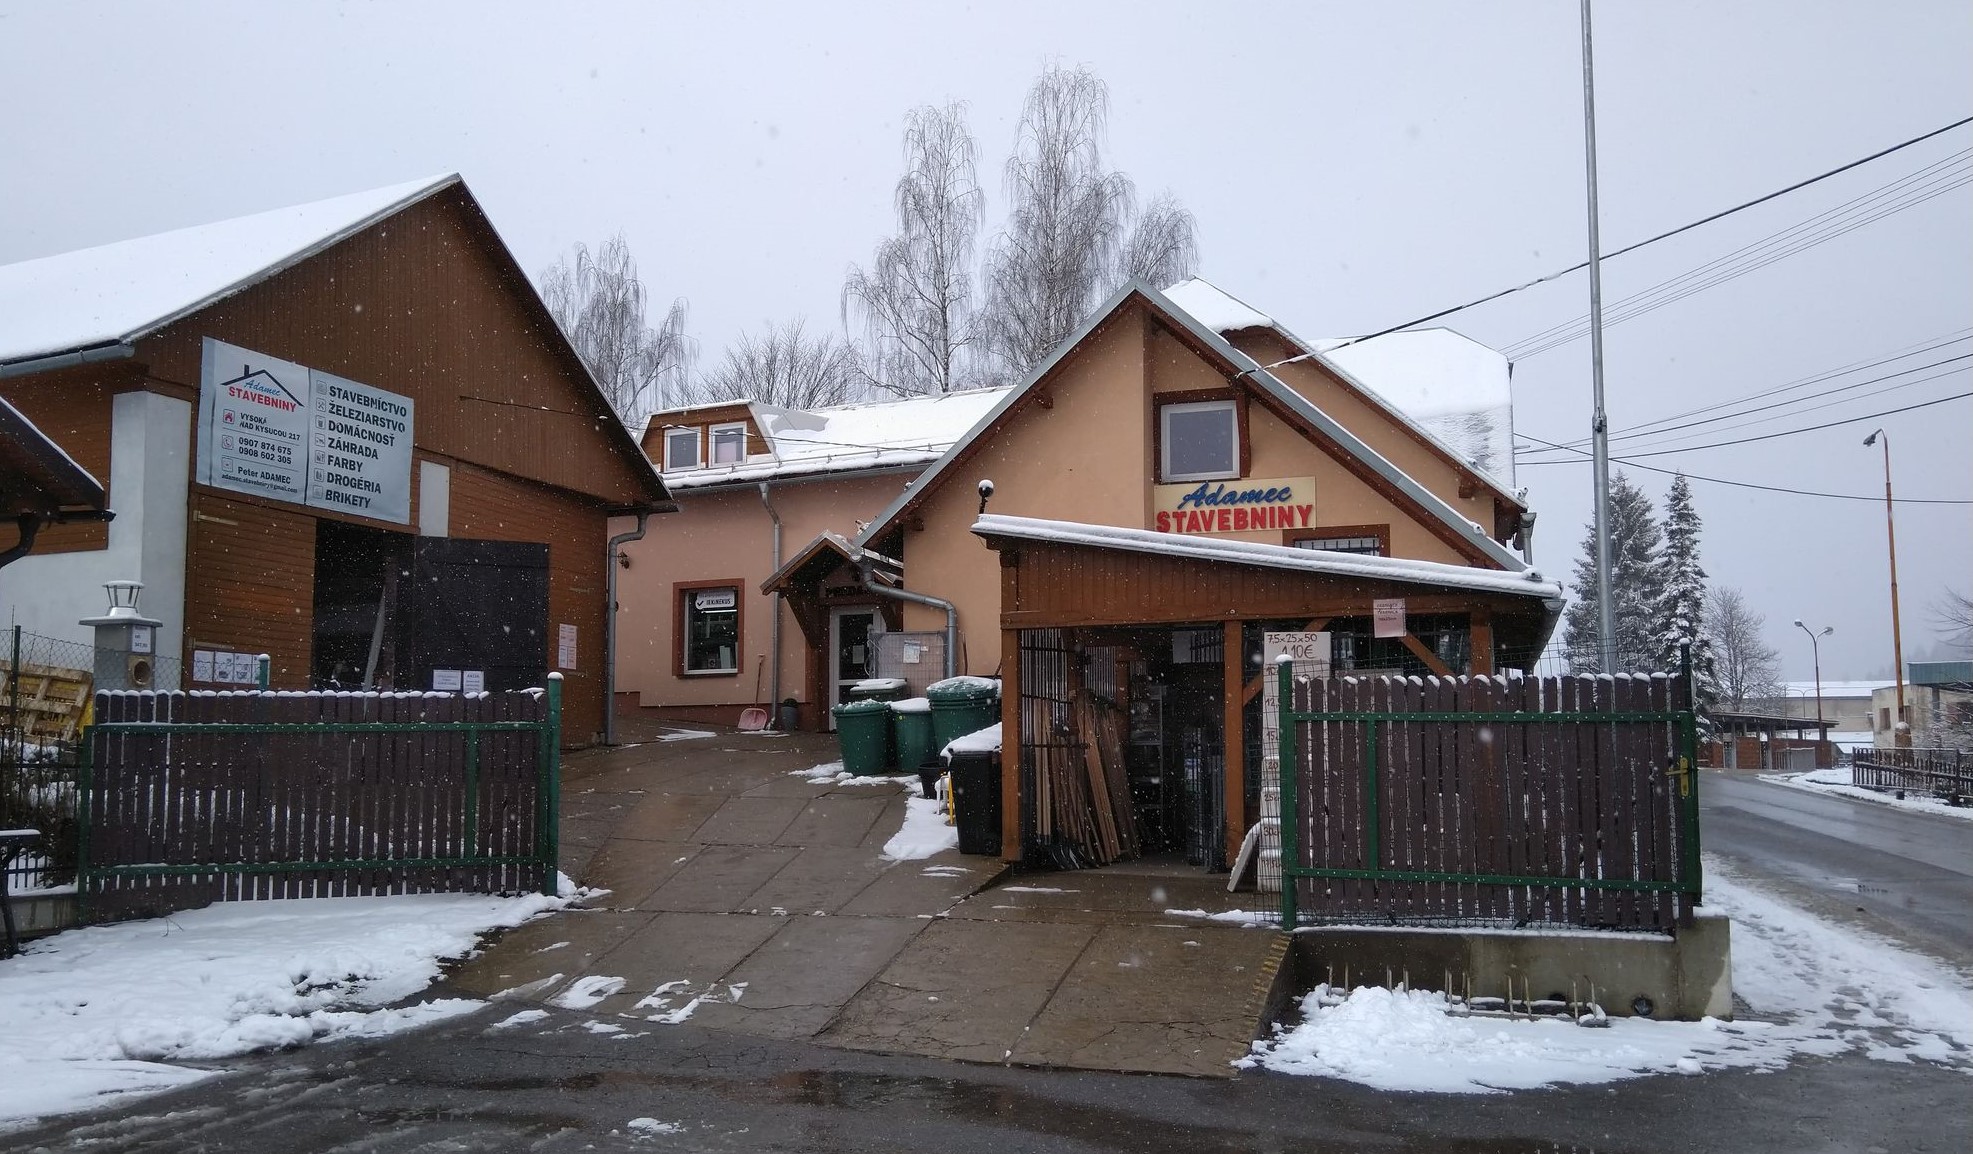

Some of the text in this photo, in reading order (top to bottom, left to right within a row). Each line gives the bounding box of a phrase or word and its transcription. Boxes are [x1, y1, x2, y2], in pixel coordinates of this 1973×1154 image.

[244, 380, 281, 397] Adamec
[228, 386, 297, 413] STAVEBNINY
[329, 385, 407, 418] STAVEBNÍCTVO
[240, 412, 267, 425] VYSOKÁ
[328, 400, 406, 433] ŽELEZIARSTVO
[239, 421, 301, 441] NAD KYSUCOU 217
[328, 420, 395, 447] DOMÁCNOSŤ
[238, 437, 292, 456] 0907 874 675
[238, 447, 292, 465] 0908 602 305
[327, 436, 379, 460] ZÁHRADA
[327, 454, 363, 473] FARBY
[237, 466, 291, 484] Peter ADAMEC
[326, 471, 382, 494] DROGÉRIA
[325, 489, 371, 508] BRIKETY
[1177, 480, 1293, 510] Adamec
[1156, 504, 1314, 534] STAVEBNINY
